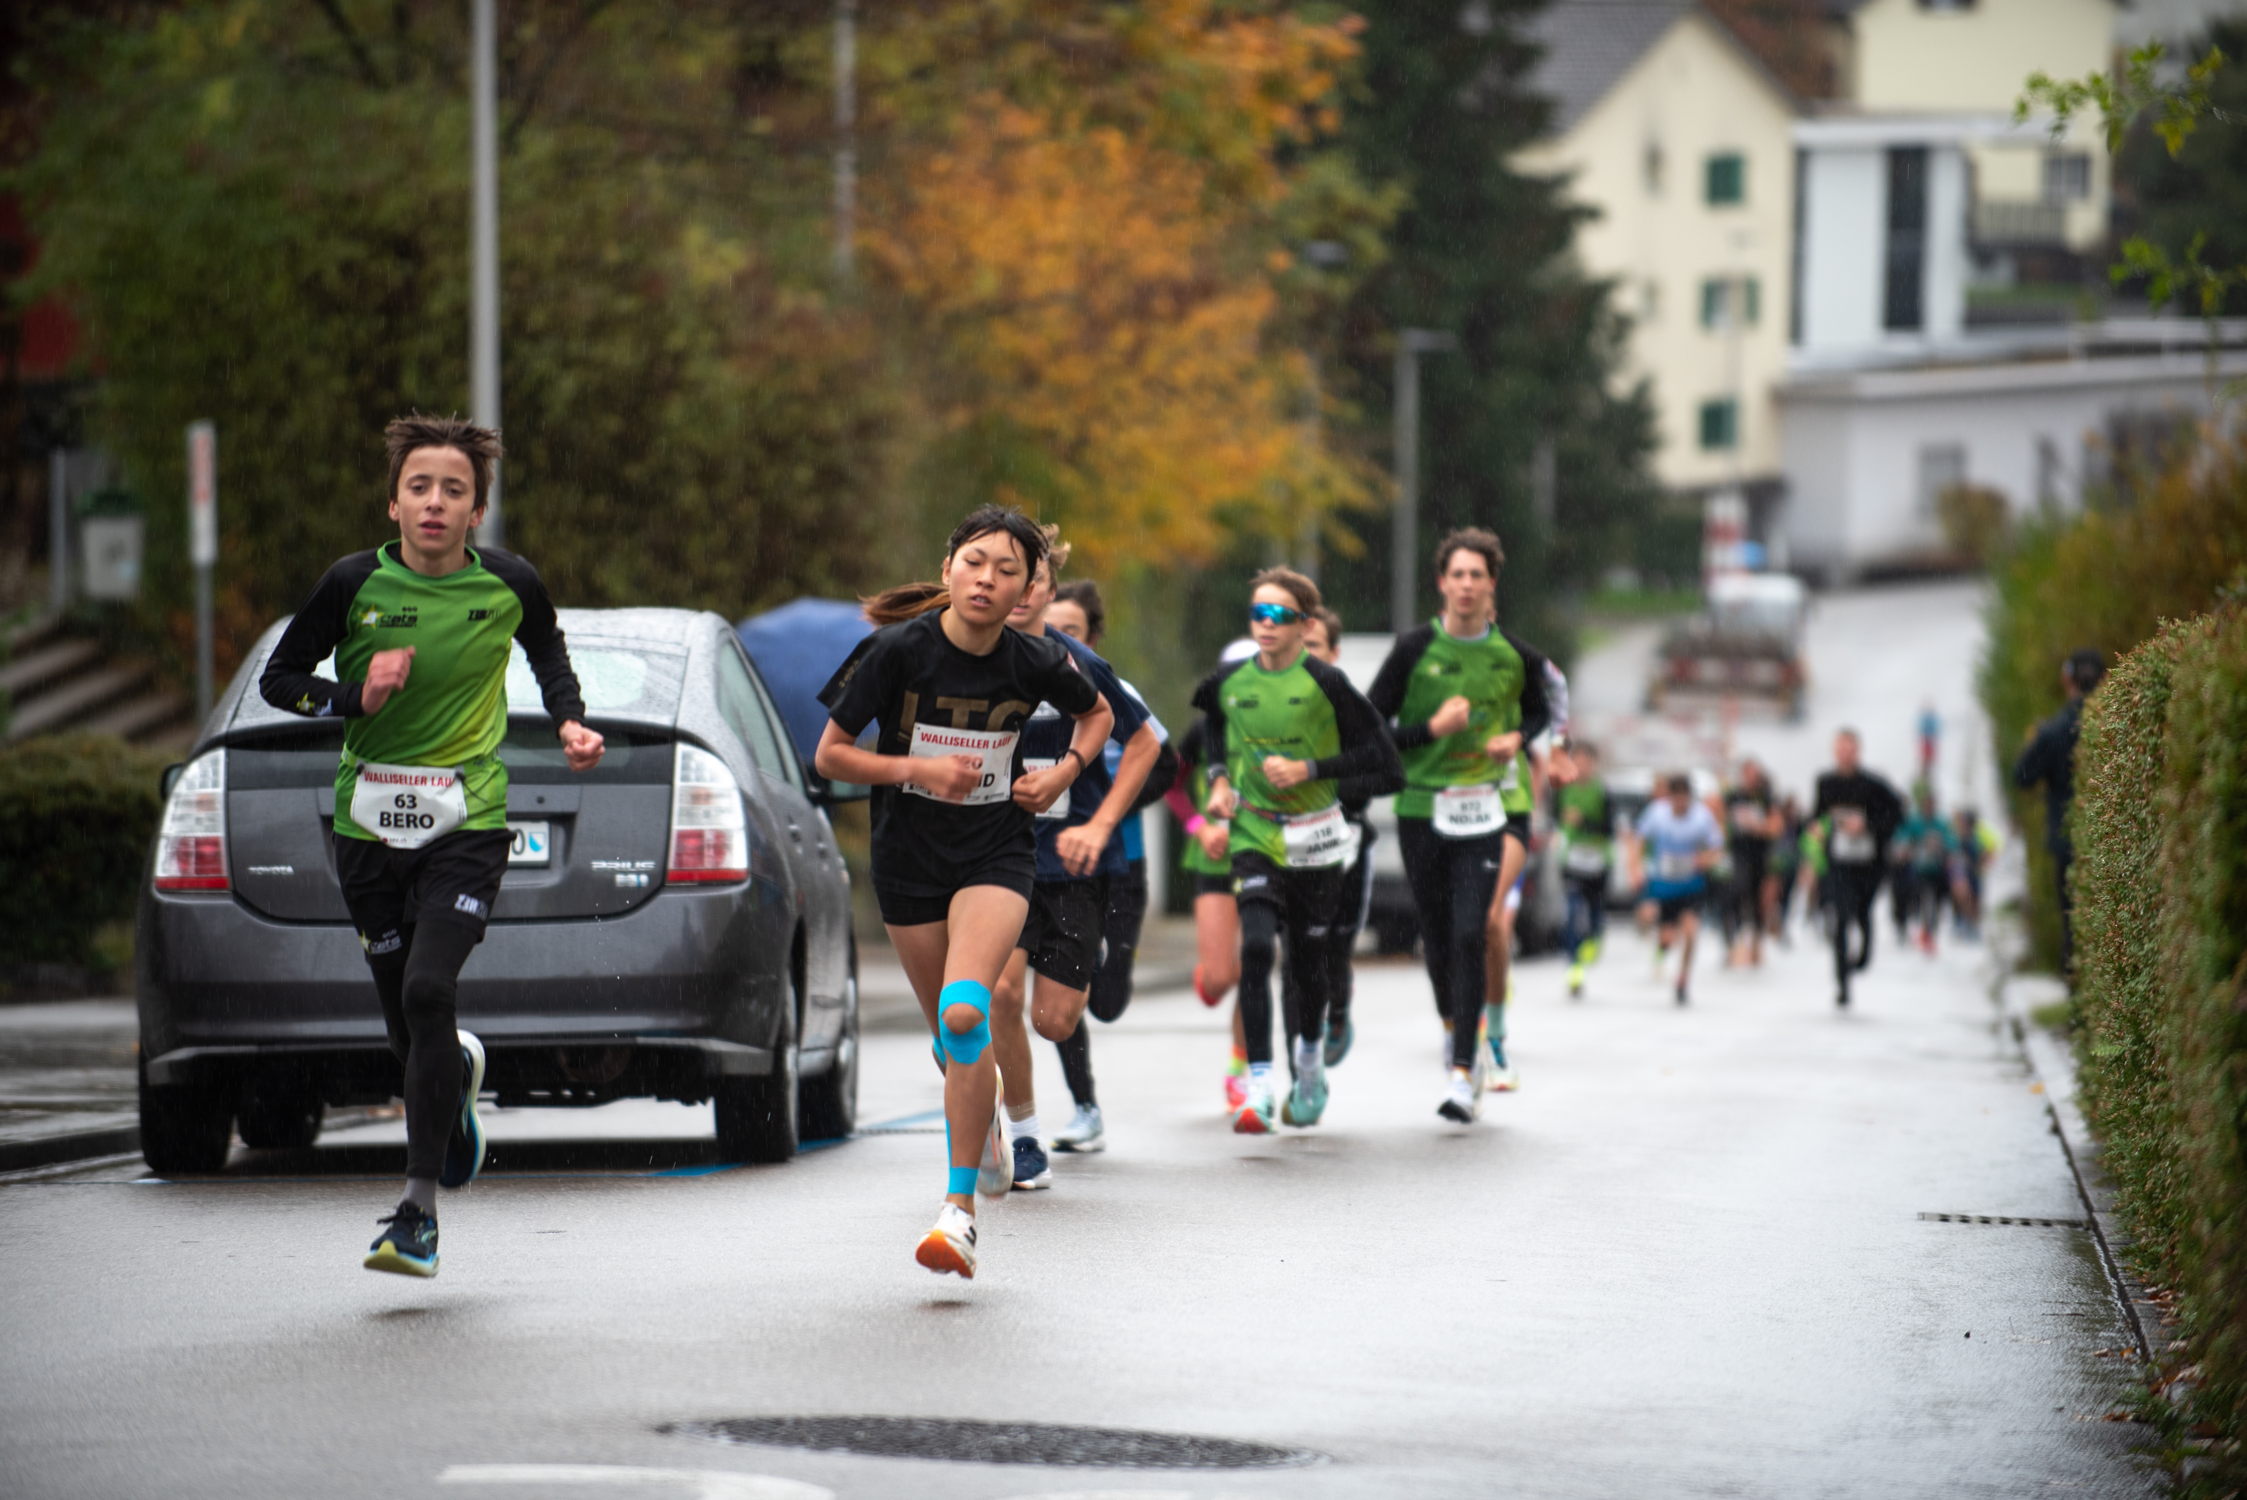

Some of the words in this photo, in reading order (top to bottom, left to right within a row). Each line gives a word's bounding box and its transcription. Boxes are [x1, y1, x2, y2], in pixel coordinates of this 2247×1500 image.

[921, 732, 989, 749] WALLISELLER
[364, 771, 427, 786] WALLISELLER
[431, 776, 456, 787] LAU
[394, 794, 417, 809] 63
[379, 811, 435, 829] BERO
